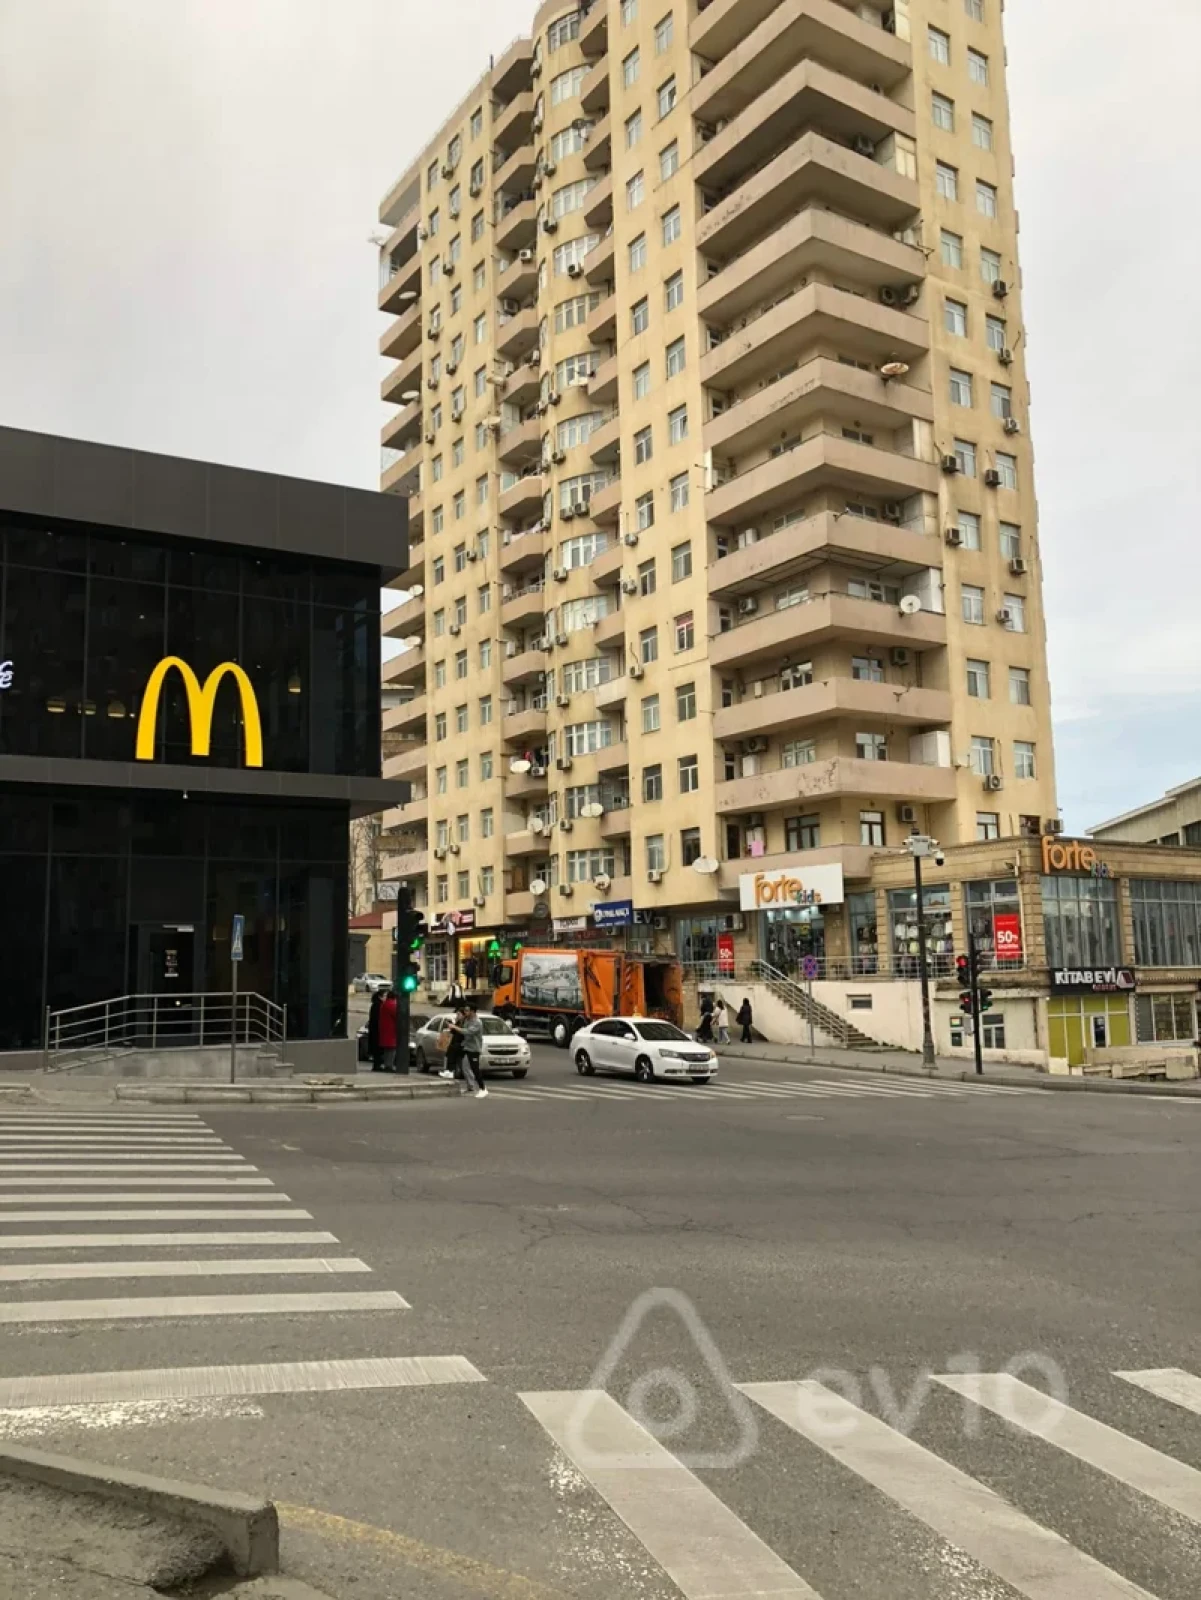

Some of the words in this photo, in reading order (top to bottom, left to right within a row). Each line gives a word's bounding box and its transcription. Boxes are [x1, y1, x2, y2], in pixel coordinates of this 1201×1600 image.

[135, 656, 263, 767] M
[1042, 836, 1096, 875] forte
[754, 874, 803, 907] forte
